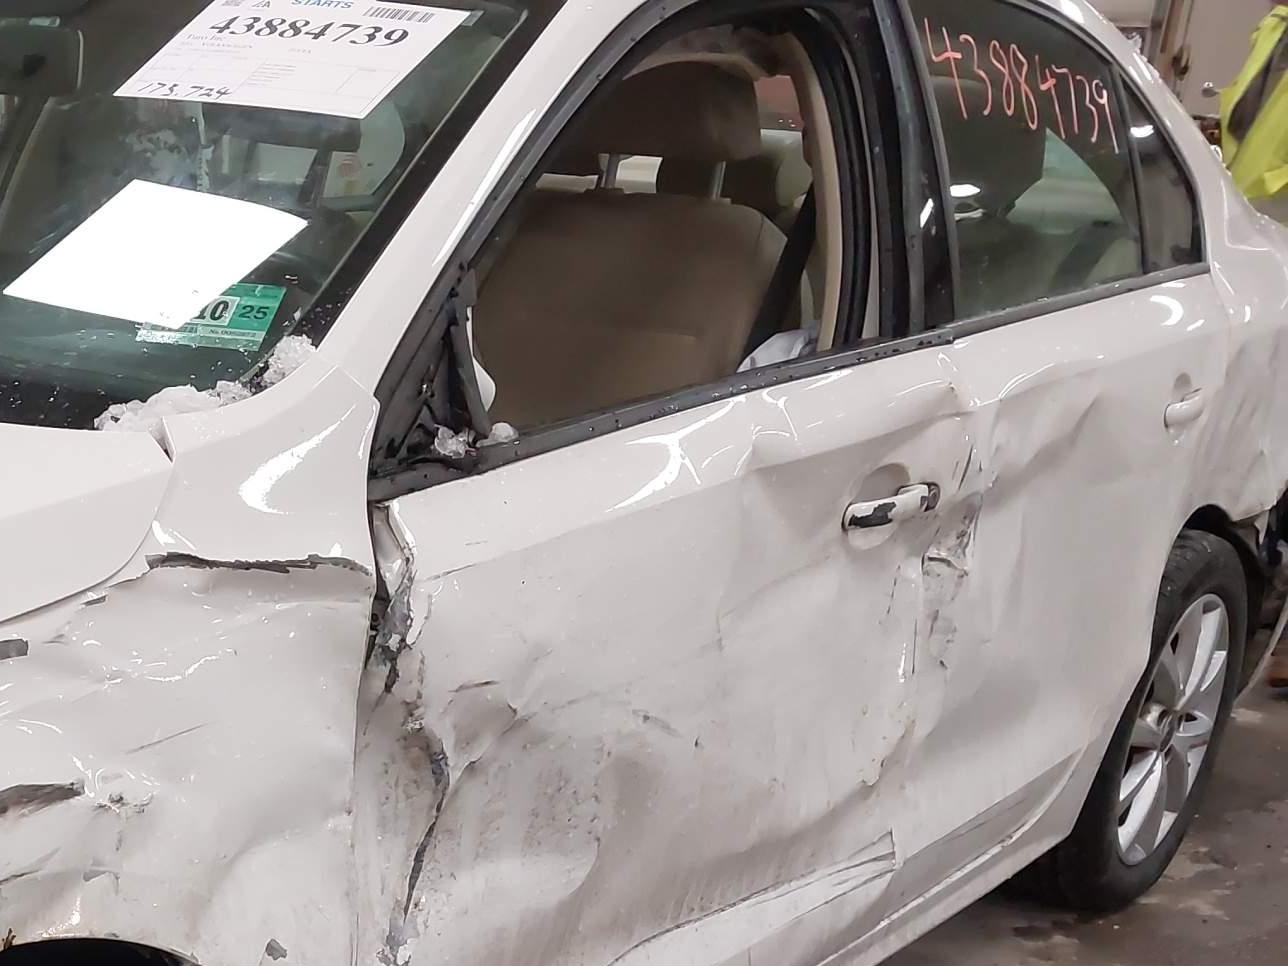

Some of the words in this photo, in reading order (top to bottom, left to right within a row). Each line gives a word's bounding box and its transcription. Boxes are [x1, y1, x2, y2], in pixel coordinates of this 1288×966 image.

[208, 15, 410, 47] 43884739
[923, 18, 1120, 154] 43884739
[238, 304, 270, 320] 25
